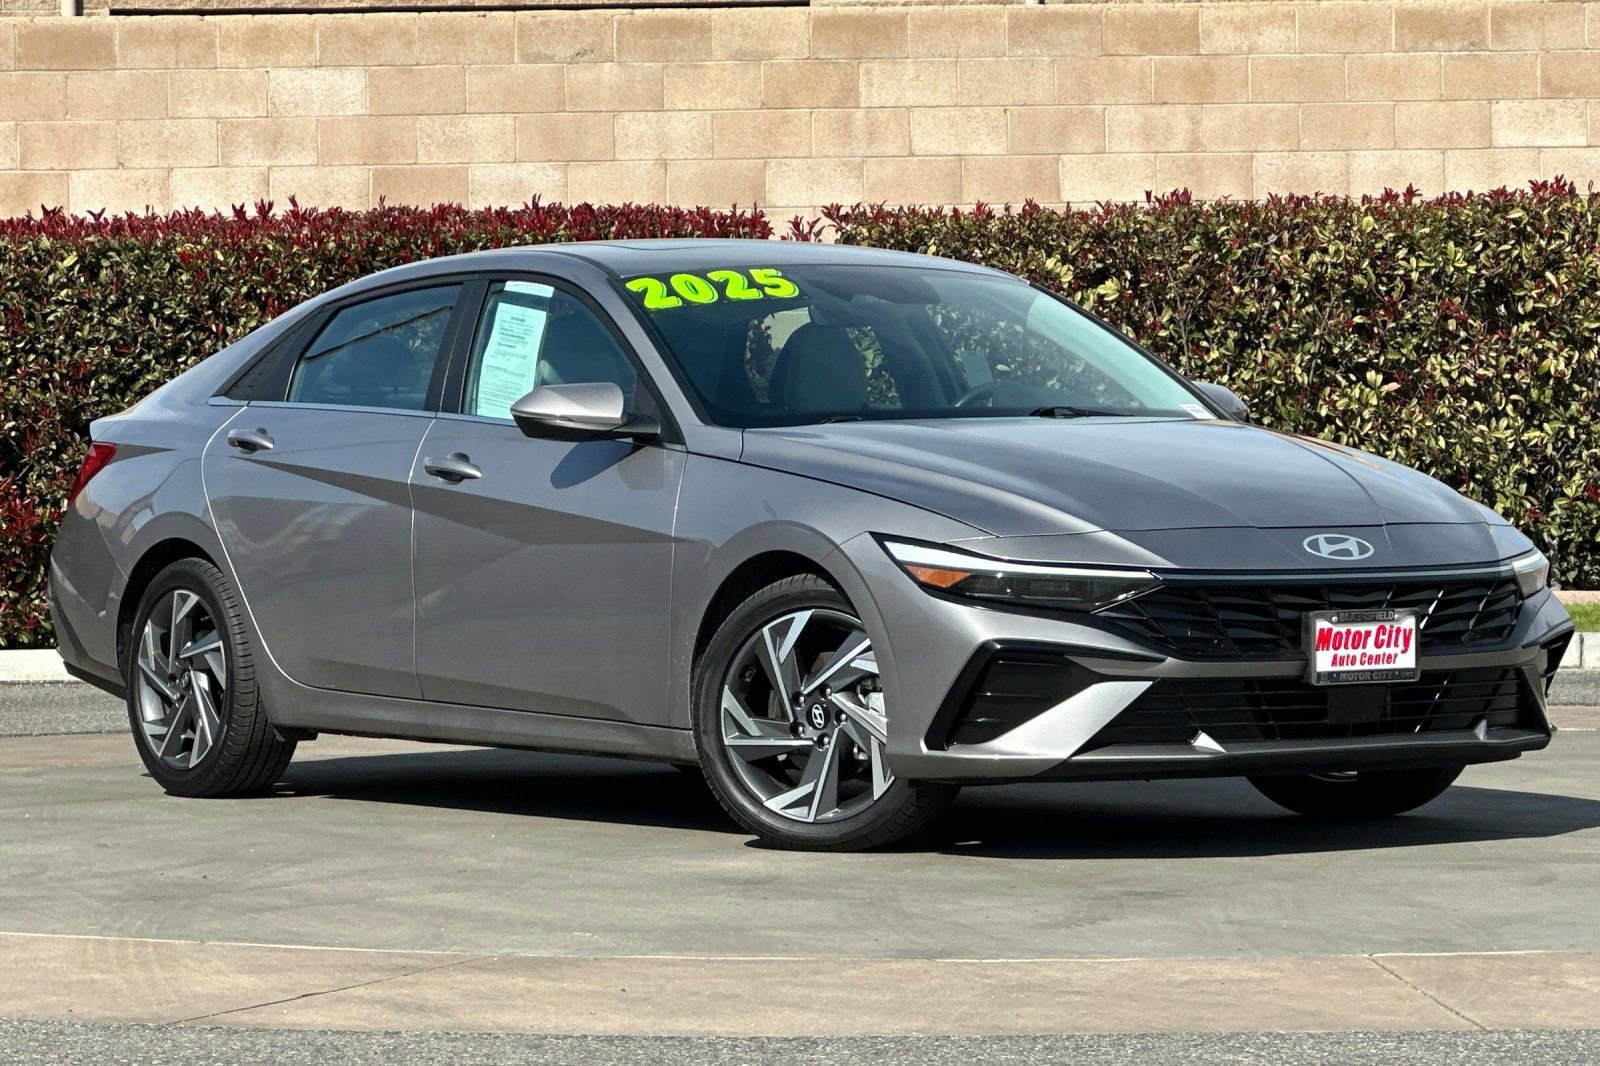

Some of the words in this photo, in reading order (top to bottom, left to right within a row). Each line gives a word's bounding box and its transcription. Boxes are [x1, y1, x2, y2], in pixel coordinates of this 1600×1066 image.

[625, 268, 799, 309] 2025
[1315, 627, 1372, 651] Motor
[1374, 624, 1413, 654] City
[1331, 653, 1357, 667] Auto
[1360, 652, 1398, 666] Center
[1339, 671, 1371, 681] MOTOR
[1372, 670, 1394, 680] CITY
